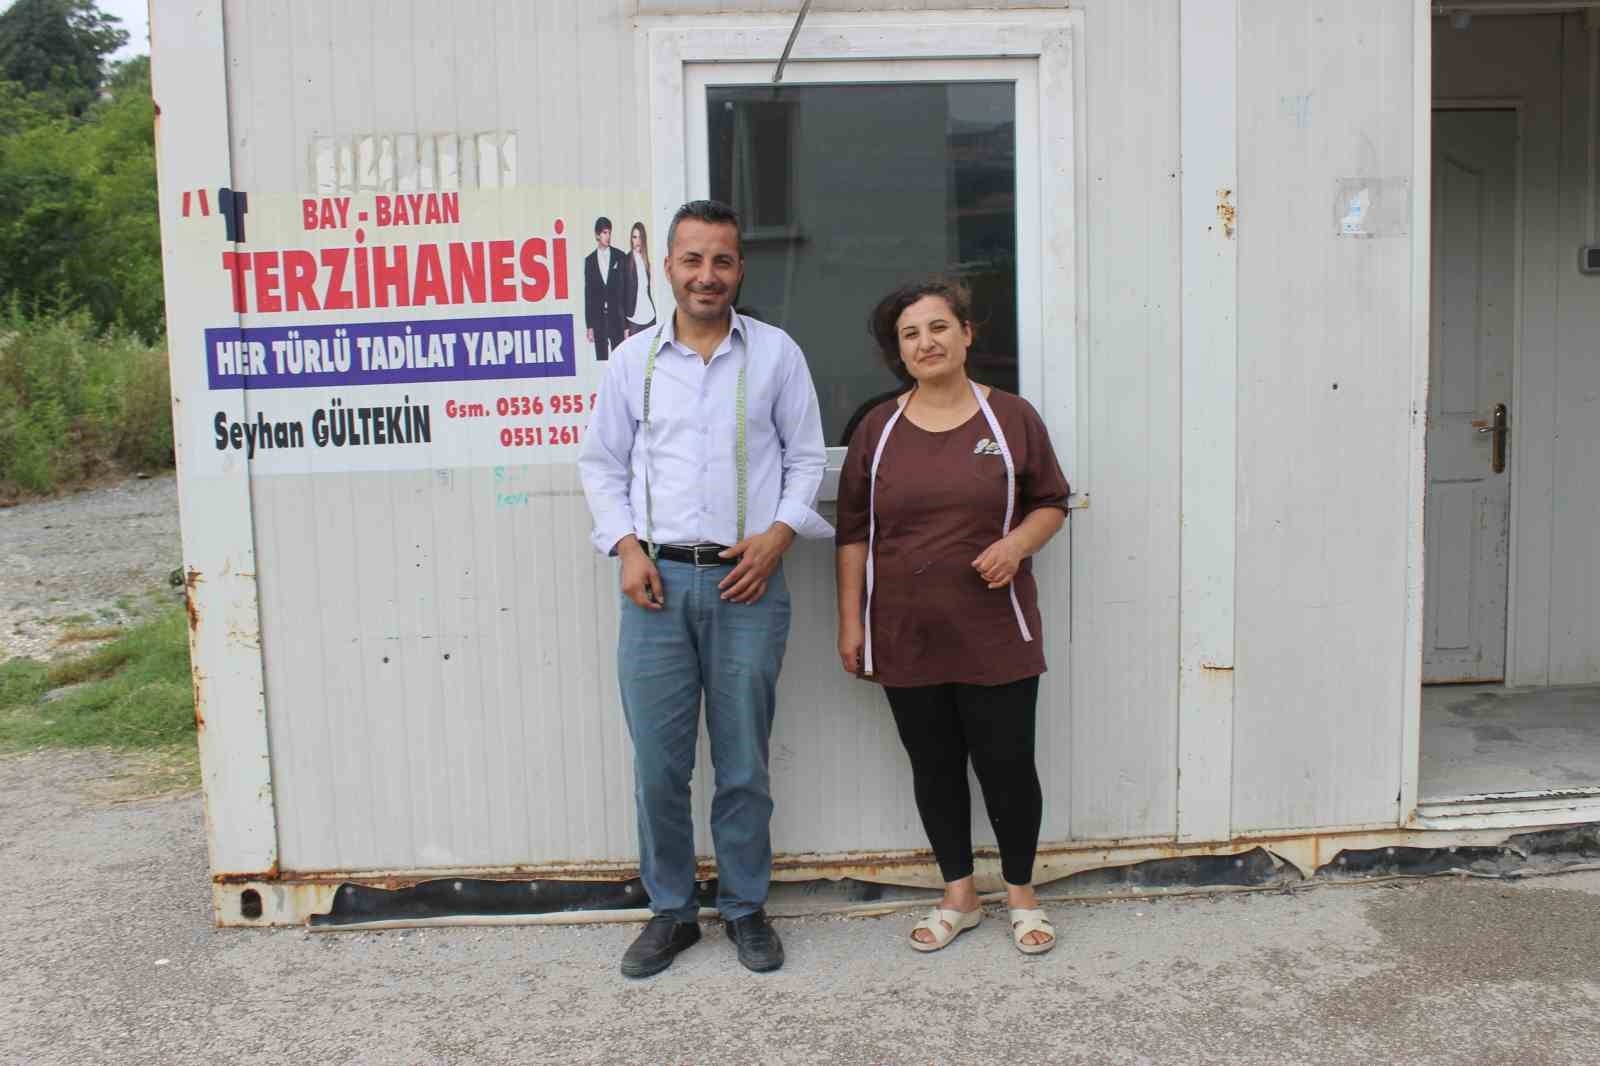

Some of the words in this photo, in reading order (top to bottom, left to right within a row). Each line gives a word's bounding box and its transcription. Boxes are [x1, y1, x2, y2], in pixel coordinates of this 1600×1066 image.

[302, 197, 351, 230] BAY
[375, 192, 460, 227] BAYAN
[222, 219, 569, 314] TERZİHANESİ
[216, 341, 268, 376] HER
[272, 328, 351, 374] TÜRLÜ
[357, 325, 457, 371] TADİLAT
[462, 329, 565, 367] YAPILIR
[214, 411, 305, 460] Seyhan
[312, 395, 432, 447] GÜLTEKİN
[446, 399, 490, 418] Gsm.
[496, 396, 544, 416] 0536
[550, 394, 584, 414] 955
[501, 427, 543, 447] 0551
[548, 425, 579, 445] 261
